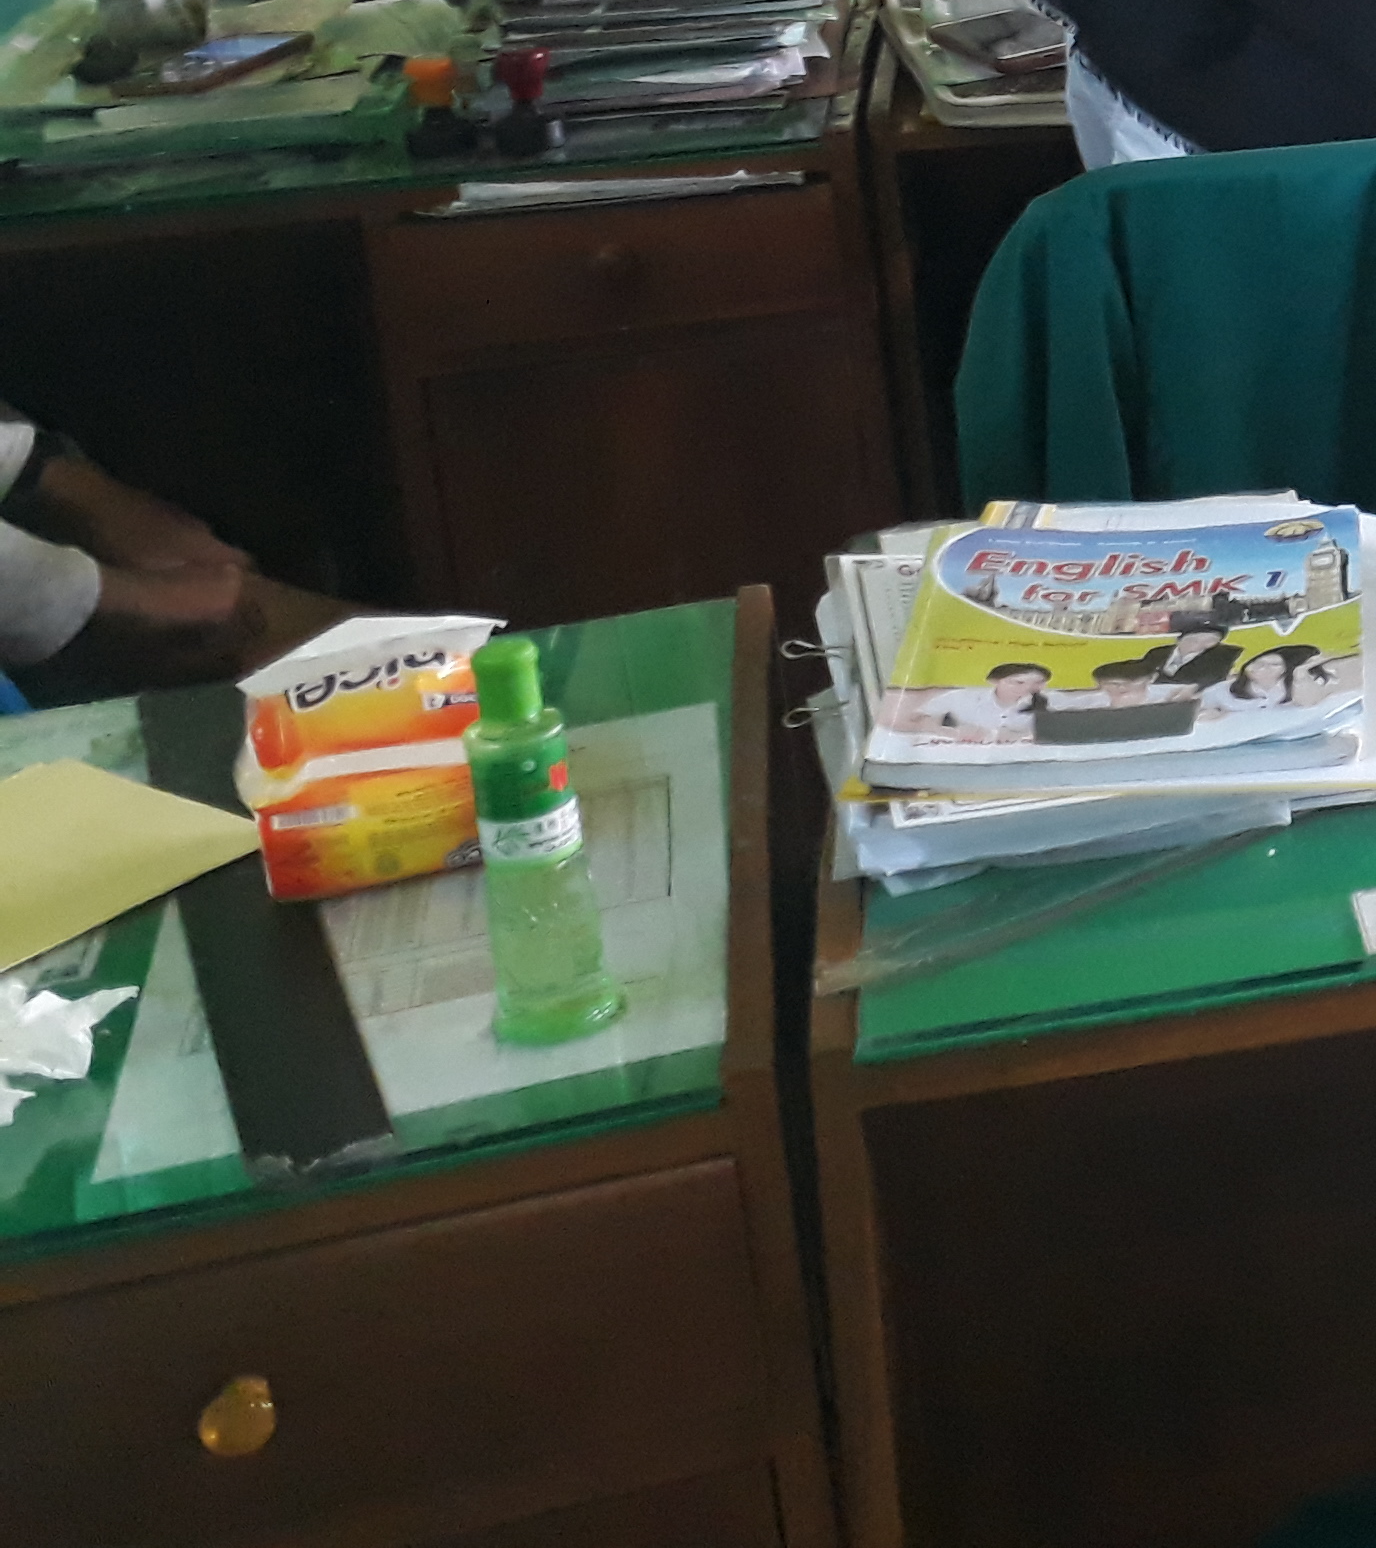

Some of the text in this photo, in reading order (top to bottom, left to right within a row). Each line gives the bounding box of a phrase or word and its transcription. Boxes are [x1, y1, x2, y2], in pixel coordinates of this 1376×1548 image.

[964, 548, 1214, 582] English
[1021, 569, 1287, 606] for SMK 1
